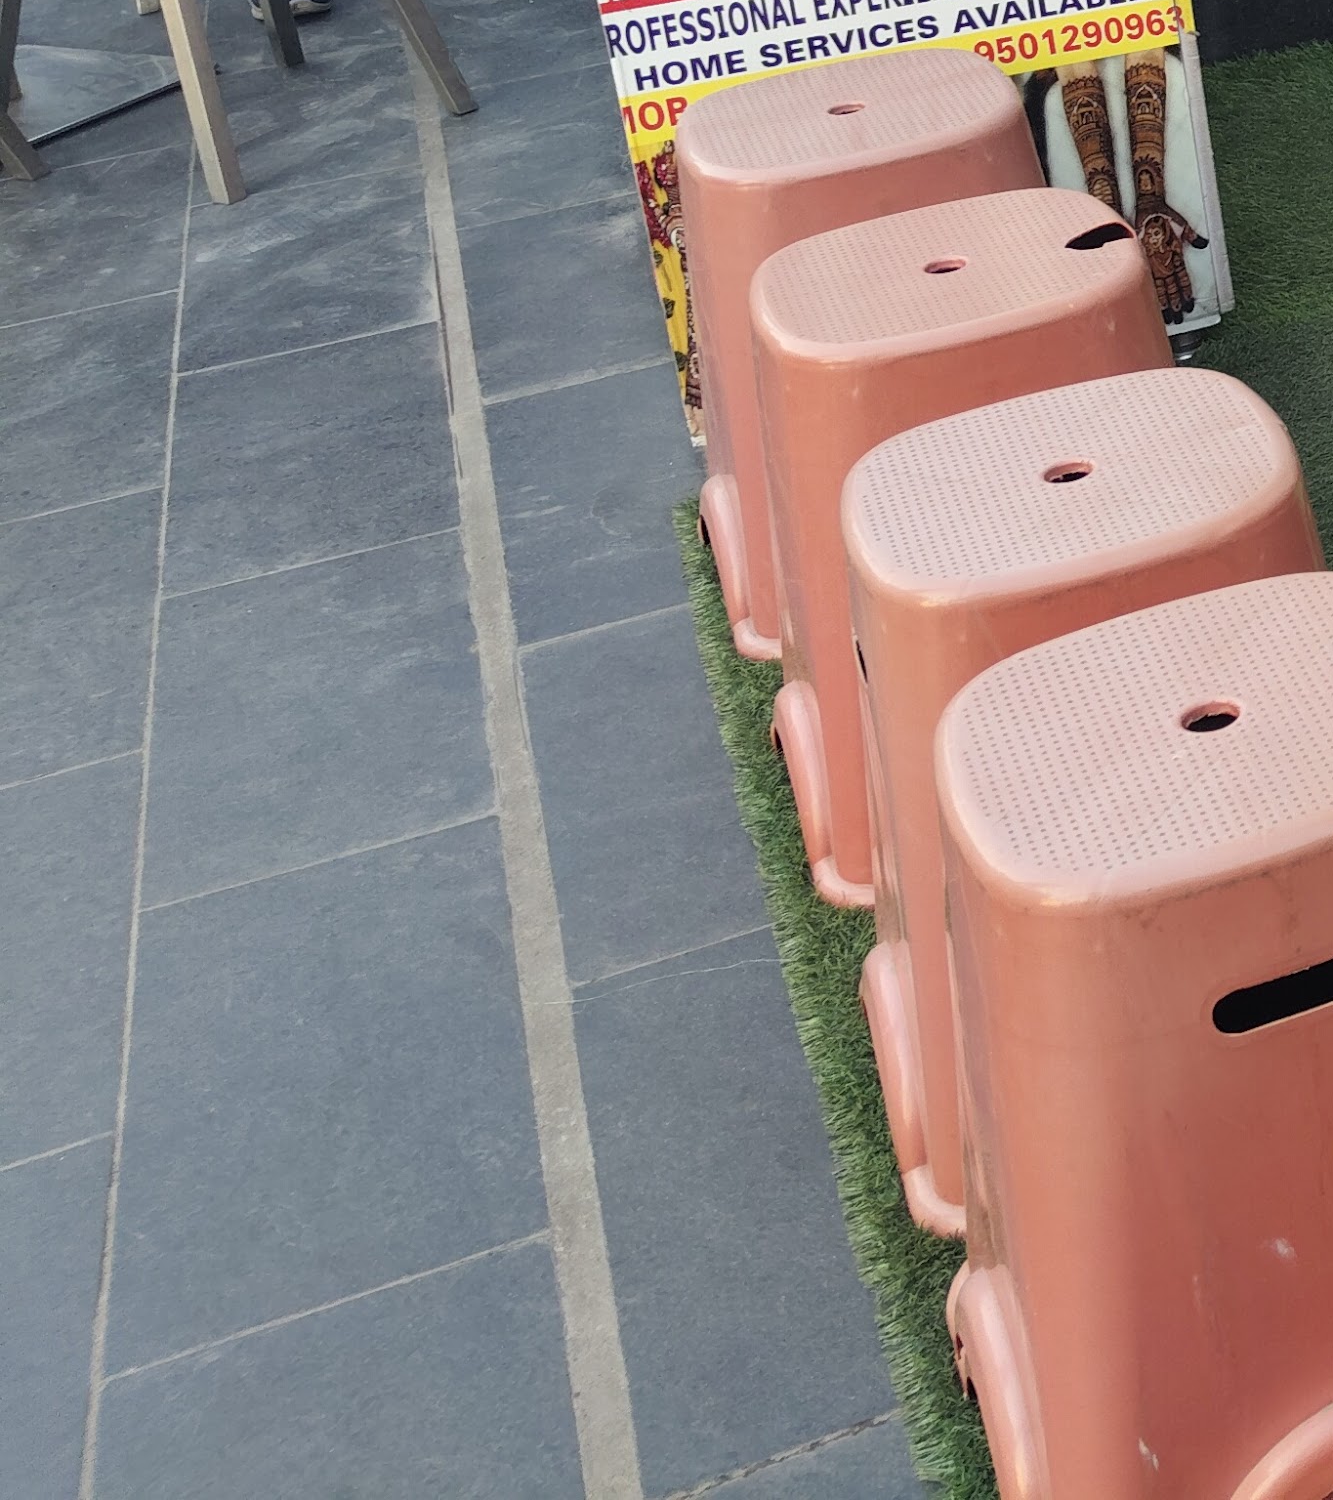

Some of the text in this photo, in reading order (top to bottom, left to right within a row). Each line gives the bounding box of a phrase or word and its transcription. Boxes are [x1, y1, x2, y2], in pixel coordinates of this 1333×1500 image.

[634, 50, 748, 92] HOME
[760, 15, 940, 68] SERVICES
[973, 5, 1184, 64] 9501290963
